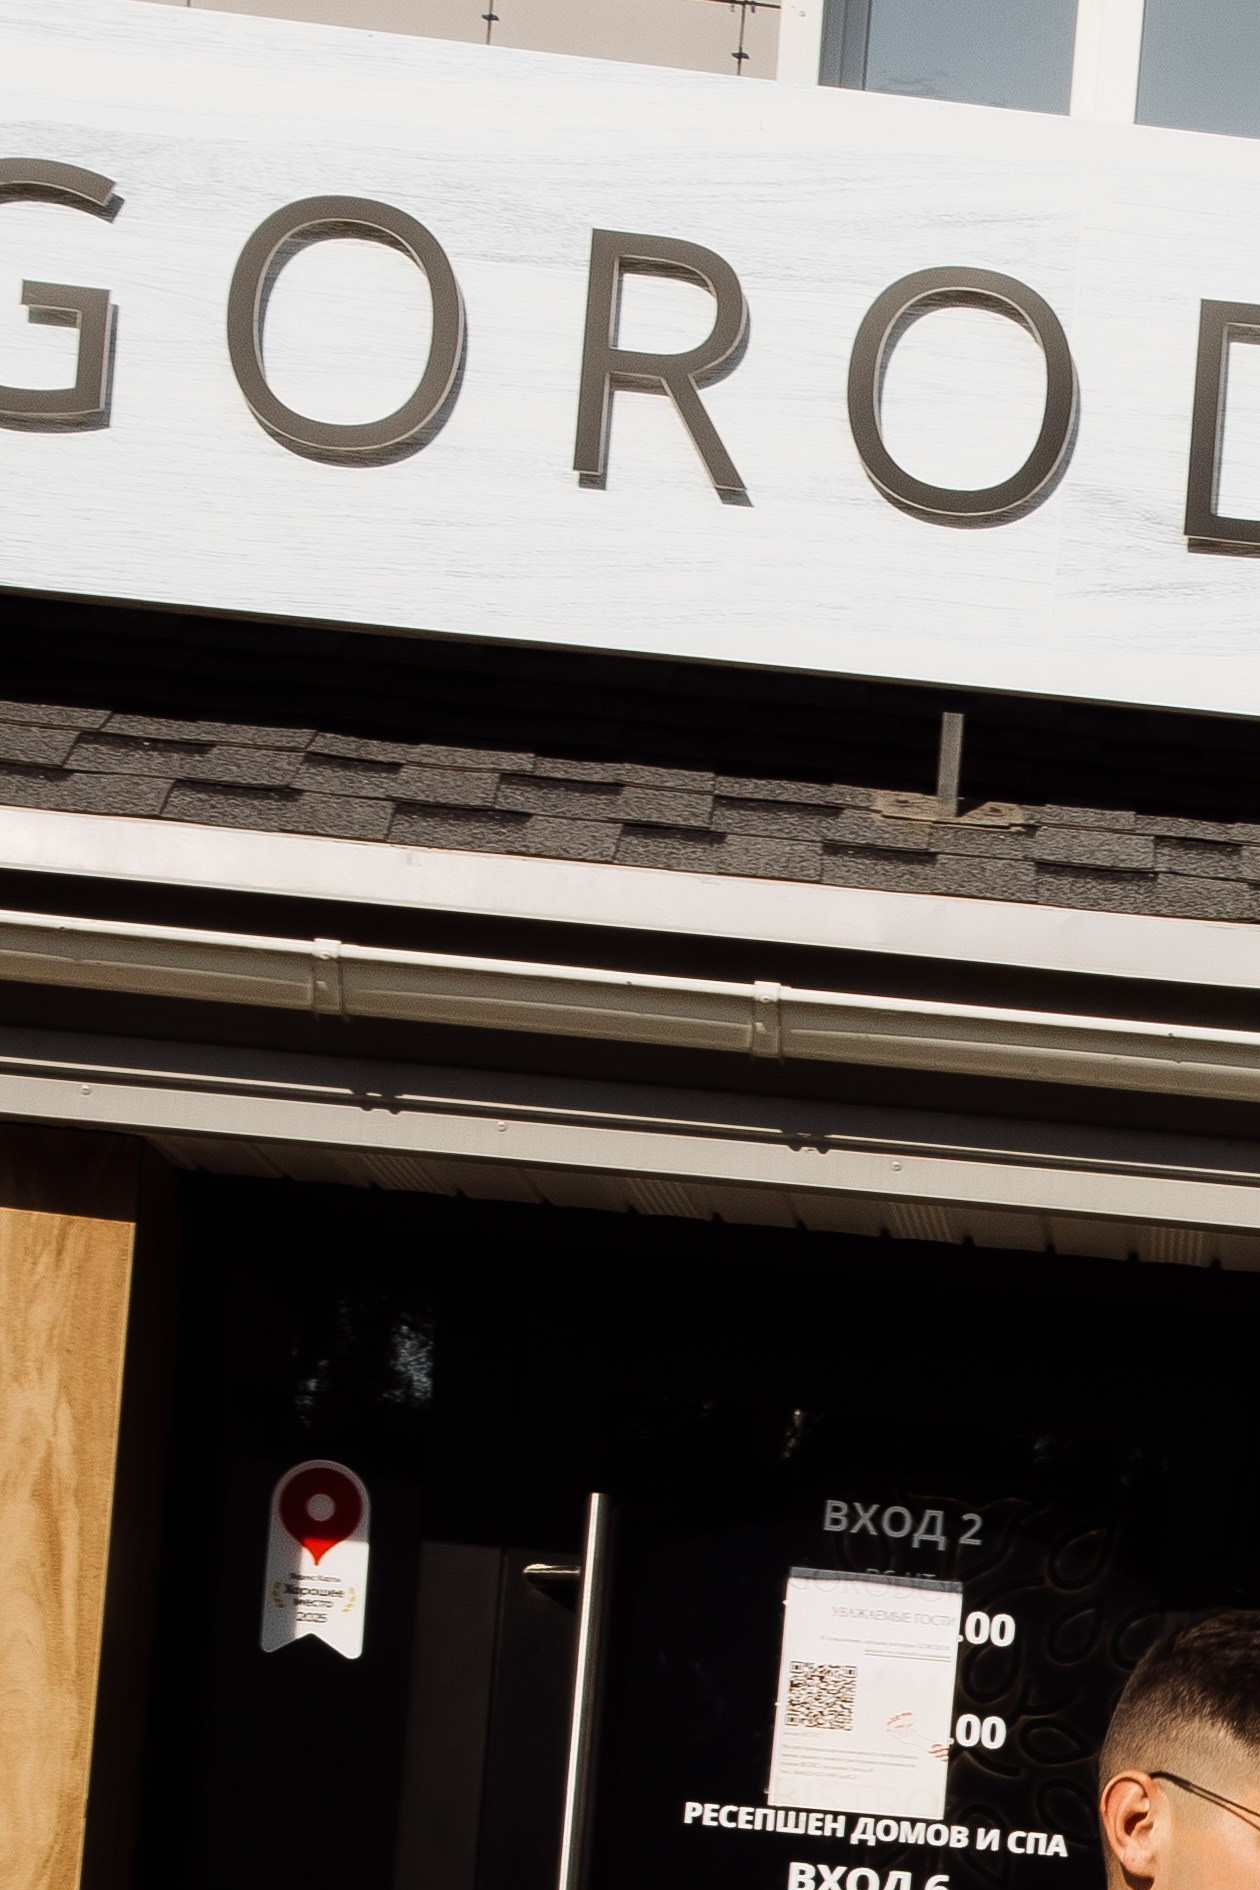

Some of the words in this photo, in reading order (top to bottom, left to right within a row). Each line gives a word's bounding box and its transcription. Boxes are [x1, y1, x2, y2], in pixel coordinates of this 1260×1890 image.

[823, 1498, 948, 1552] ВХОД
[958, 1512, 983, 1546] 2
[683, 1801, 847, 1838] РЕСЕПШЕН
[849, 1816, 970, 1849] ДОМОВ
[975, 1827, 1001, 1852] И
[1006, 1830, 1069, 1858] СПА
